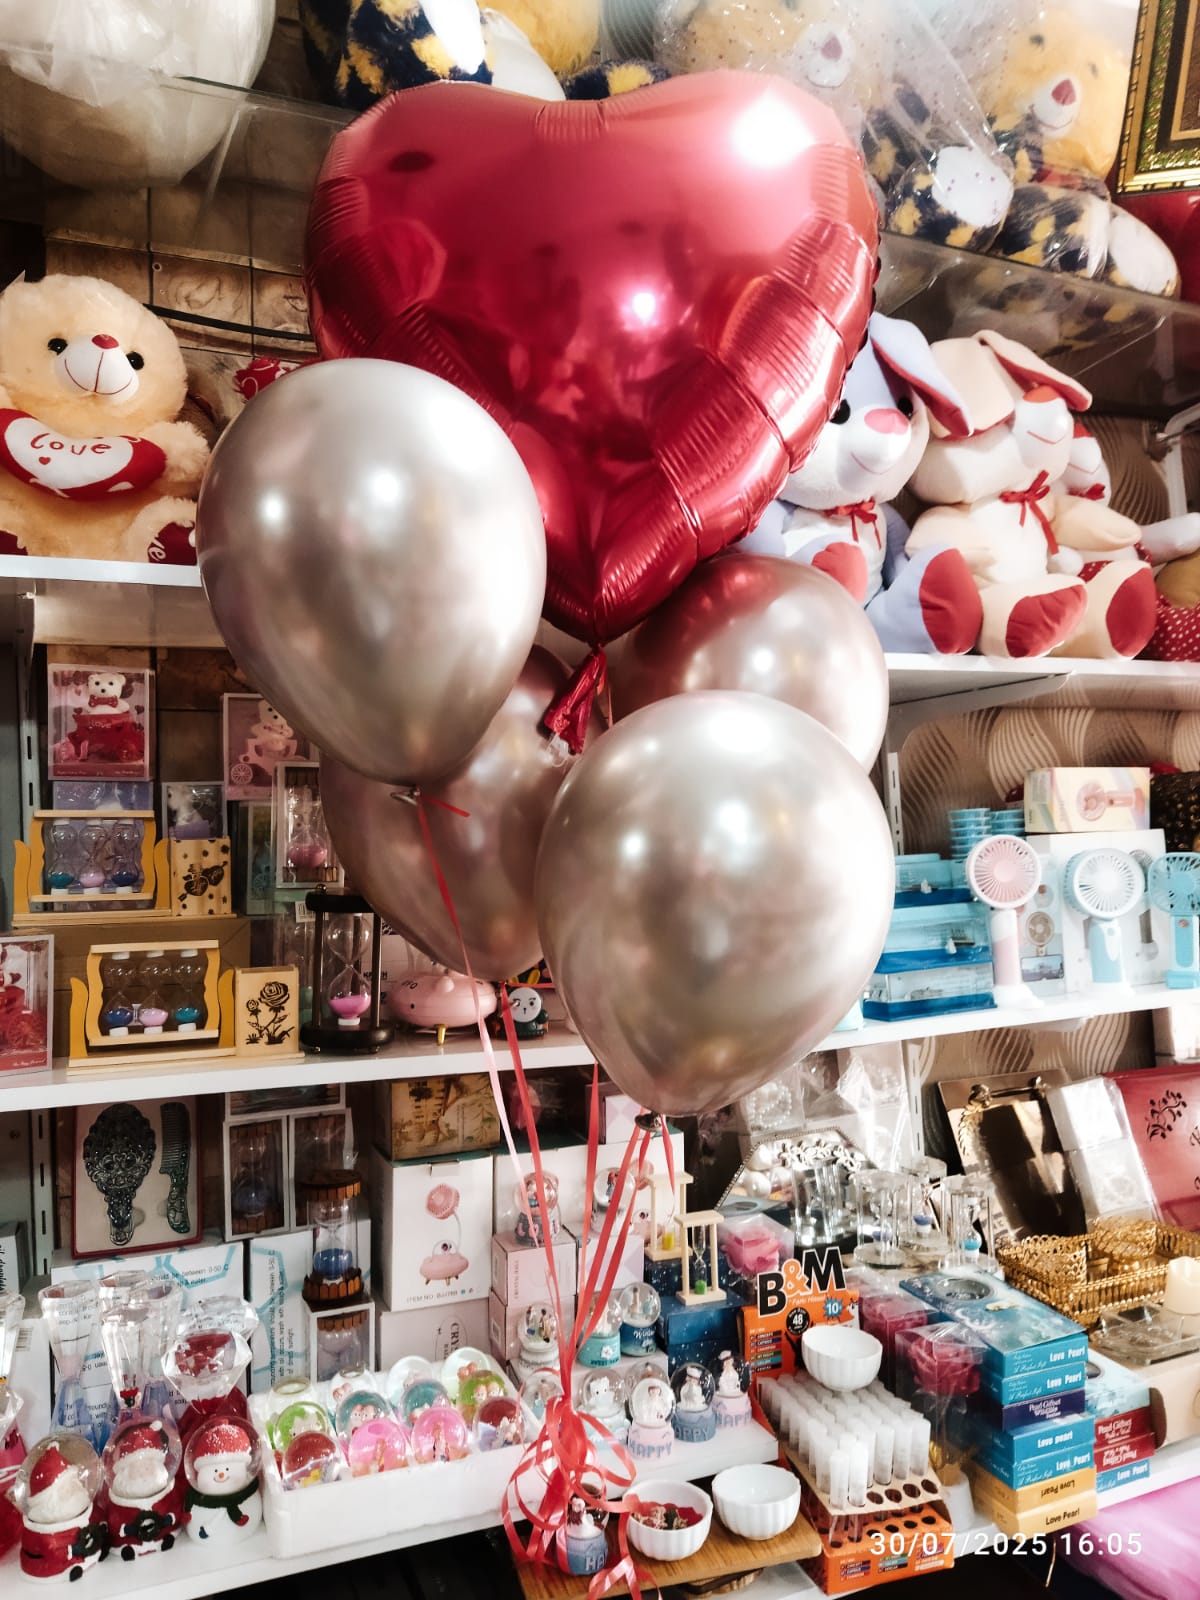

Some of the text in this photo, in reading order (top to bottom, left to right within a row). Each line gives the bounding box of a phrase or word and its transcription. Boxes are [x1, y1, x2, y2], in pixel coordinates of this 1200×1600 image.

[757, 1246, 847, 1318] B&M
[1037, 1437, 1053, 1449] Love
[1056, 1459, 1071, 1472] Love
[1045, 1507, 1080, 1526] Love Pearl
